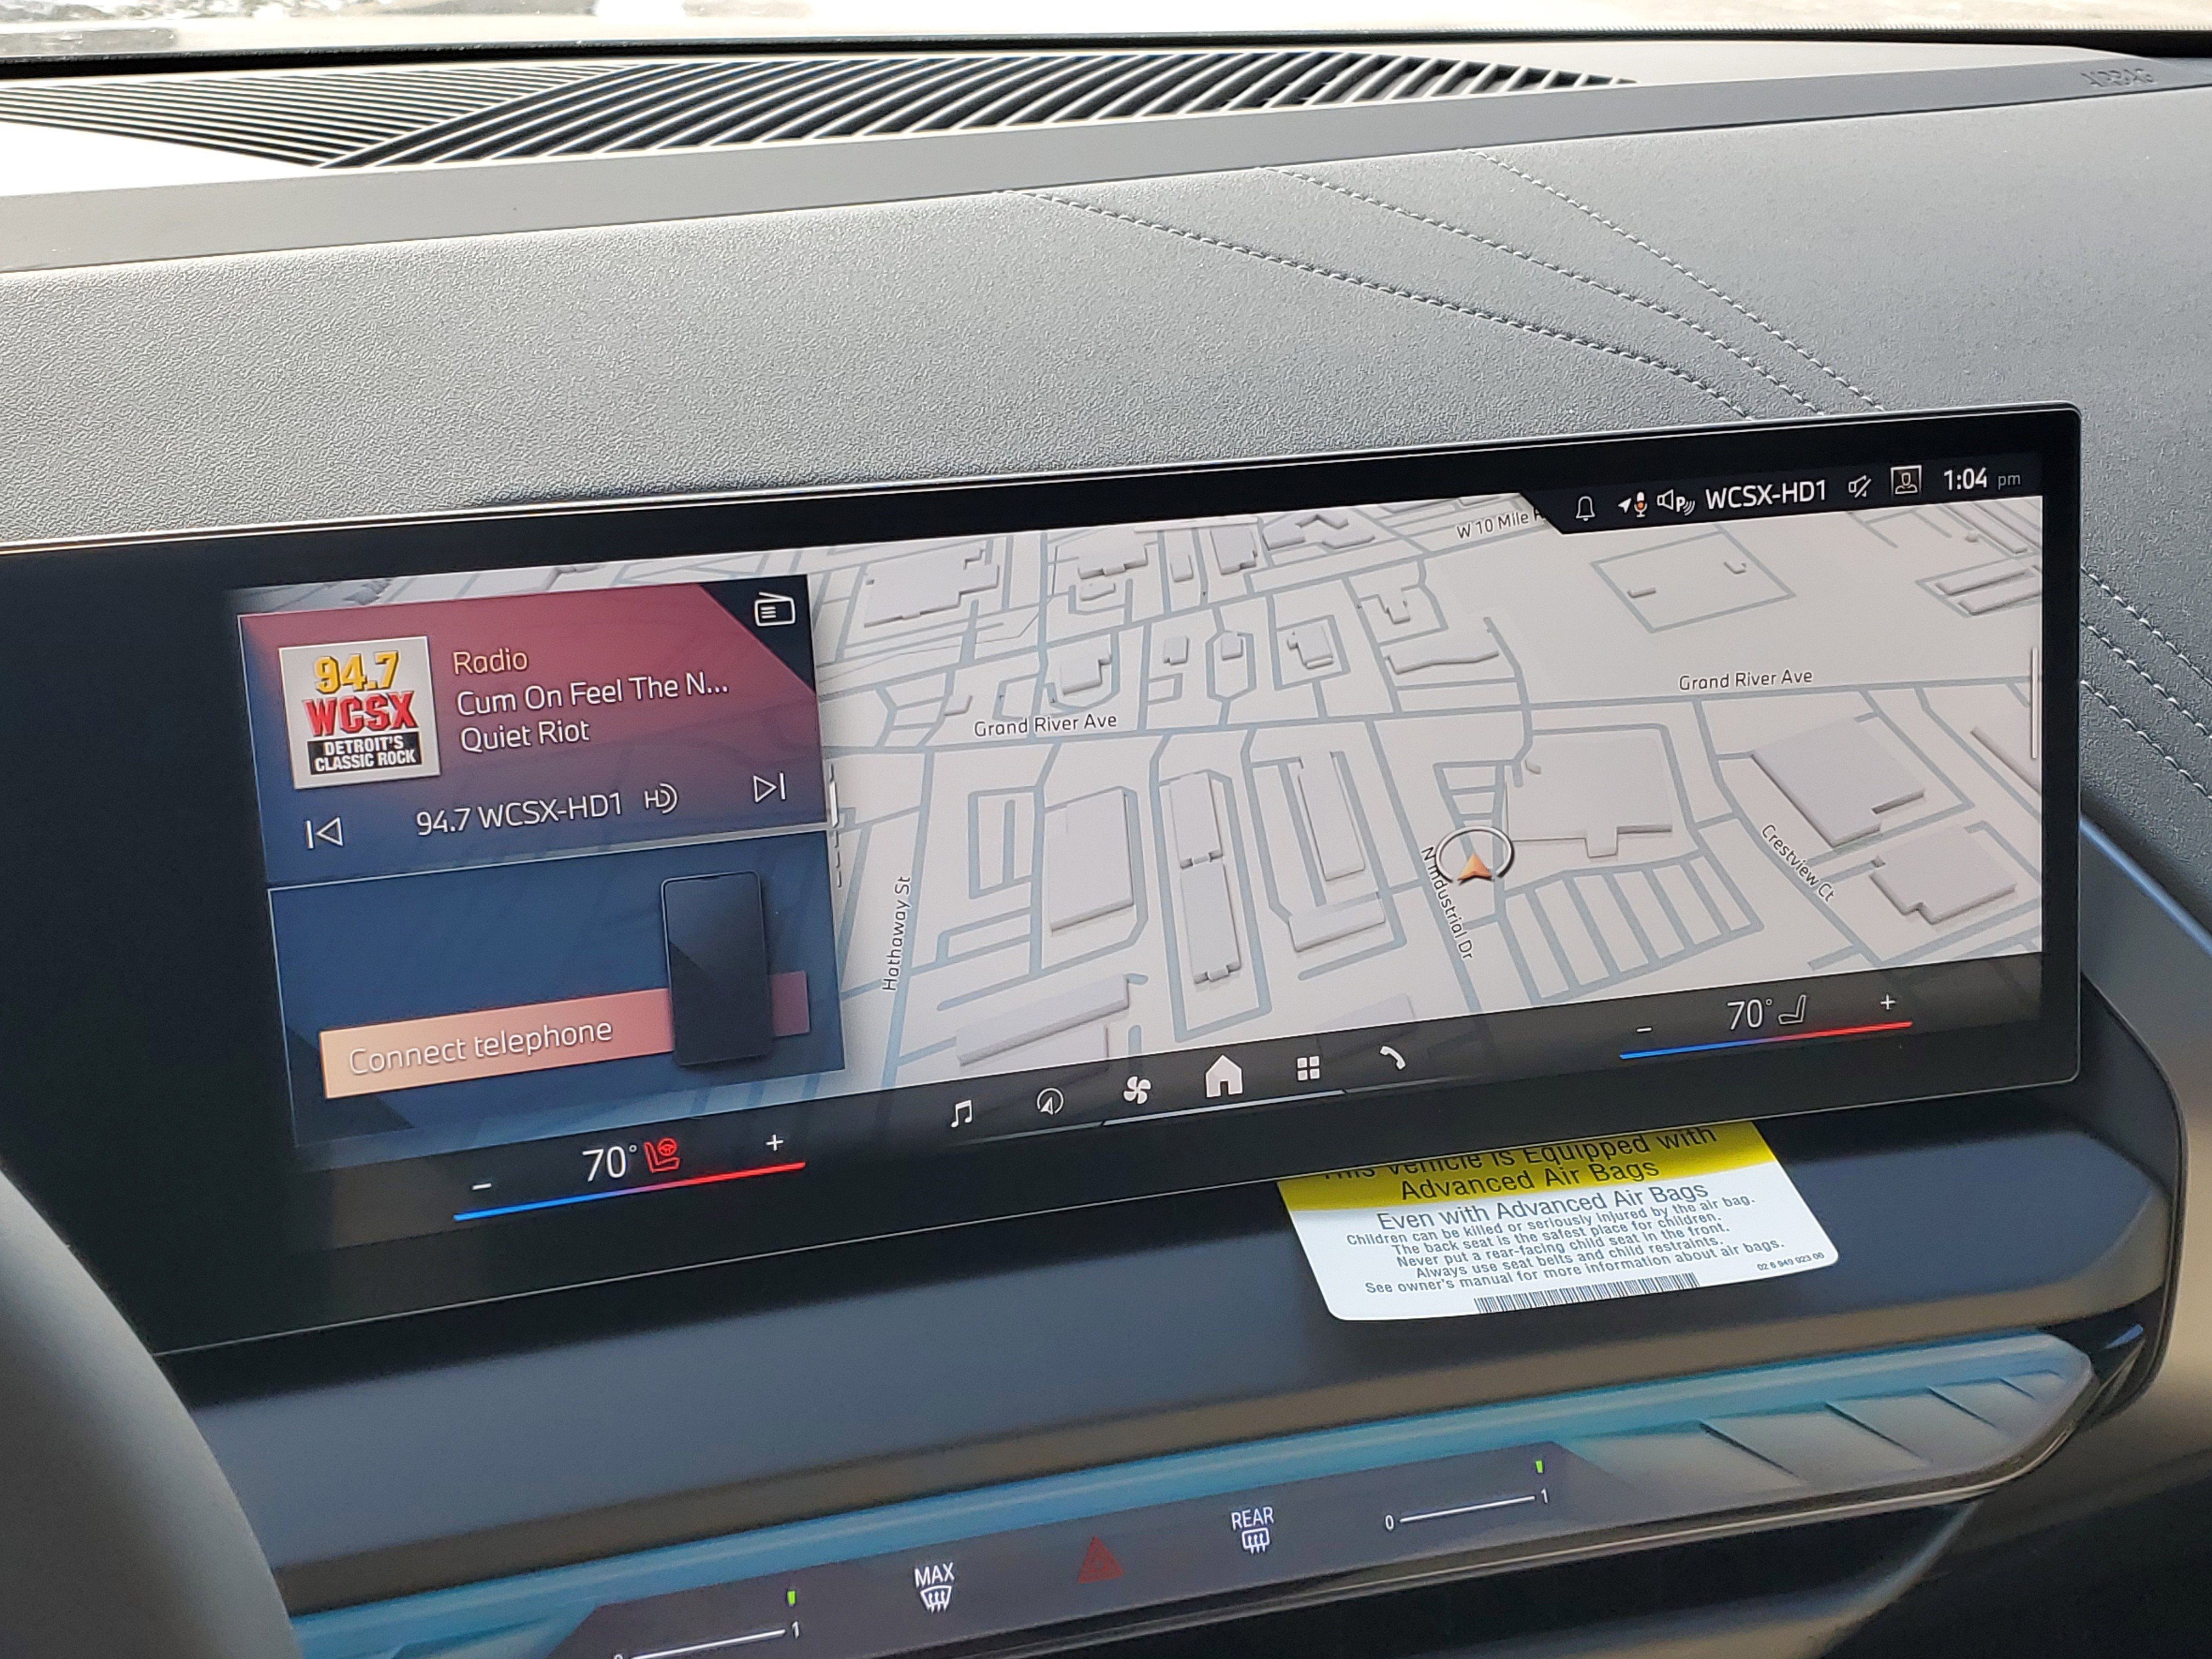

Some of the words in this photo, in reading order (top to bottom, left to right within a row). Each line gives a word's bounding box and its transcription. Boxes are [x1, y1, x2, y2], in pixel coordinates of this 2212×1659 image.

[1705, 480, 1826, 510] WCSX-HD1
[1943, 467, 1988, 491] 1:04
[1997, 472, 2021, 490] pm
[1457, 523, 1470, 539] W
[1476, 518, 1493, 534] 10
[1498, 511, 1529, 530] Mile
[314, 650, 399, 695] 94.7
[452, 648, 528, 675] Radio
[1679, 673, 1729, 690] Grand
[1735, 672, 1777, 687] River
[1781, 670, 1813, 684] Ave
[302, 691, 419, 737] WCSX
[456, 690, 517, 716] Cum
[524, 685, 563, 710] On
[569, 678, 623, 706] Feel
[628, 676, 679, 700] The
[686, 672, 729, 696] N...
[323, 736, 404, 756] DETROIT'S
[460, 725, 531, 753] Quiet
[538, 719, 590, 744] Riot
[974, 718, 1028, 737] Grand
[1035, 716, 1079, 732] River
[1084, 714, 1117, 729] Ave
[314, 753, 375, 772] CLASSIC
[377, 749, 417, 766] ROCK
[416, 808, 471, 836] 94.7
[477, 792, 622, 829] WCSX-HD1
[1762, 825, 1819, 885] Crestview
[1818, 883, 1834, 902] Ct
[894, 877, 910, 895] St
[1421, 847, 1436, 861] N
[1458, 940, 1472, 959] Dr
[882, 899, 911, 991] Hathaway
[349, 1039, 466, 1075] Connect
[475, 1022, 612, 1056] telephone
[1523, 1135, 1650, 1165] Equipped
[1656, 1126, 1717, 1149] with
[1402, 1169, 1534, 1200] Advanced
[1544, 1167, 1579, 1187] Air
[1589, 1160, 1660, 1182] Bags
[1347, 1233, 1408, 1246] Children
[1412, 1231, 1438, 1242] can
[1441, 1228, 1460, 1239] be
[1463, 1223, 1503, 1237] killed
[1508, 1222, 1523, 1233] or
[1528, 1214, 1592, 1231] seriously
[1596, 1207, 1647, 1223] injured
[1651, 1206, 1669, 1218] by
[1674, 1202, 1696, 1214] the
[1701, 1199, 1719, 1211] air
[1722, 1195, 1756, 1208] bag.
[1376, 1212, 1434, 1230] Even
[1438, 1205, 1490, 1226] with
[1497, 1193, 1607, 1220] Advanced
[1613, 1190, 1644, 1207] Air
[1648, 1184, 1709, 1203] Bags
[1392, 1243, 1420, 1256] The
[1424, 1240, 1459, 1254] back
[1464, 1237, 1492, 1250] seat
[1497, 1234, 1511, 1246] is
[1514, 1231, 1538, 1244] the
[1542, 1227, 1587, 1242] safest
[1590, 1222, 1628, 1238] place
[1632, 1219, 1653, 1232] for
[1658, 1212, 1722, 1228] children.
[1396, 1254, 1439, 1268] Never
[1443, 1251, 1469, 1266] put
[1471, 1251, 1482, 1261] a
[1485, 1242, 1565, 1260] rear-facing
[1569, 1234, 1605, 1251] child
[1610, 1232, 1640, 1245] seat
[1641, 1231, 1657, 1242] in
[1660, 1226, 1685, 1240] the
[1688, 1222, 1730, 1236] front.
[1365, 1282, 1393, 1294] See
[1397, 1278, 1455, 1293] owner's
[1459, 1272, 1514, 1288] manual
[1516, 1269, 1539, 1282] for
[1543, 1265, 1582, 1279] more
[1584, 1254, 1673, 1274] information
[1674, 1248, 1718, 1264] about
[1720, 1244, 1740, 1257] air
[1742, 1240, 1785, 1252] bags.
[1417, 1264, 1468, 1279] Always
[1472, 1261, 1498, 1273] use
[1502, 1256, 1534, 1271] seat
[1536, 1251, 1574, 1267] belts
[1577, 1248, 1605, 1263] and
[1608, 1243, 1645, 1259] child
[1648, 1235, 1724, 1255] restraints.
[1231, 1506, 1274, 1531] REAR
[1385, 1514, 1395, 1532] 0
[1541, 1488, 1549, 1504] 1
[915, 1562, 955, 1588] MAX
[792, 1621, 800, 1639] 1
